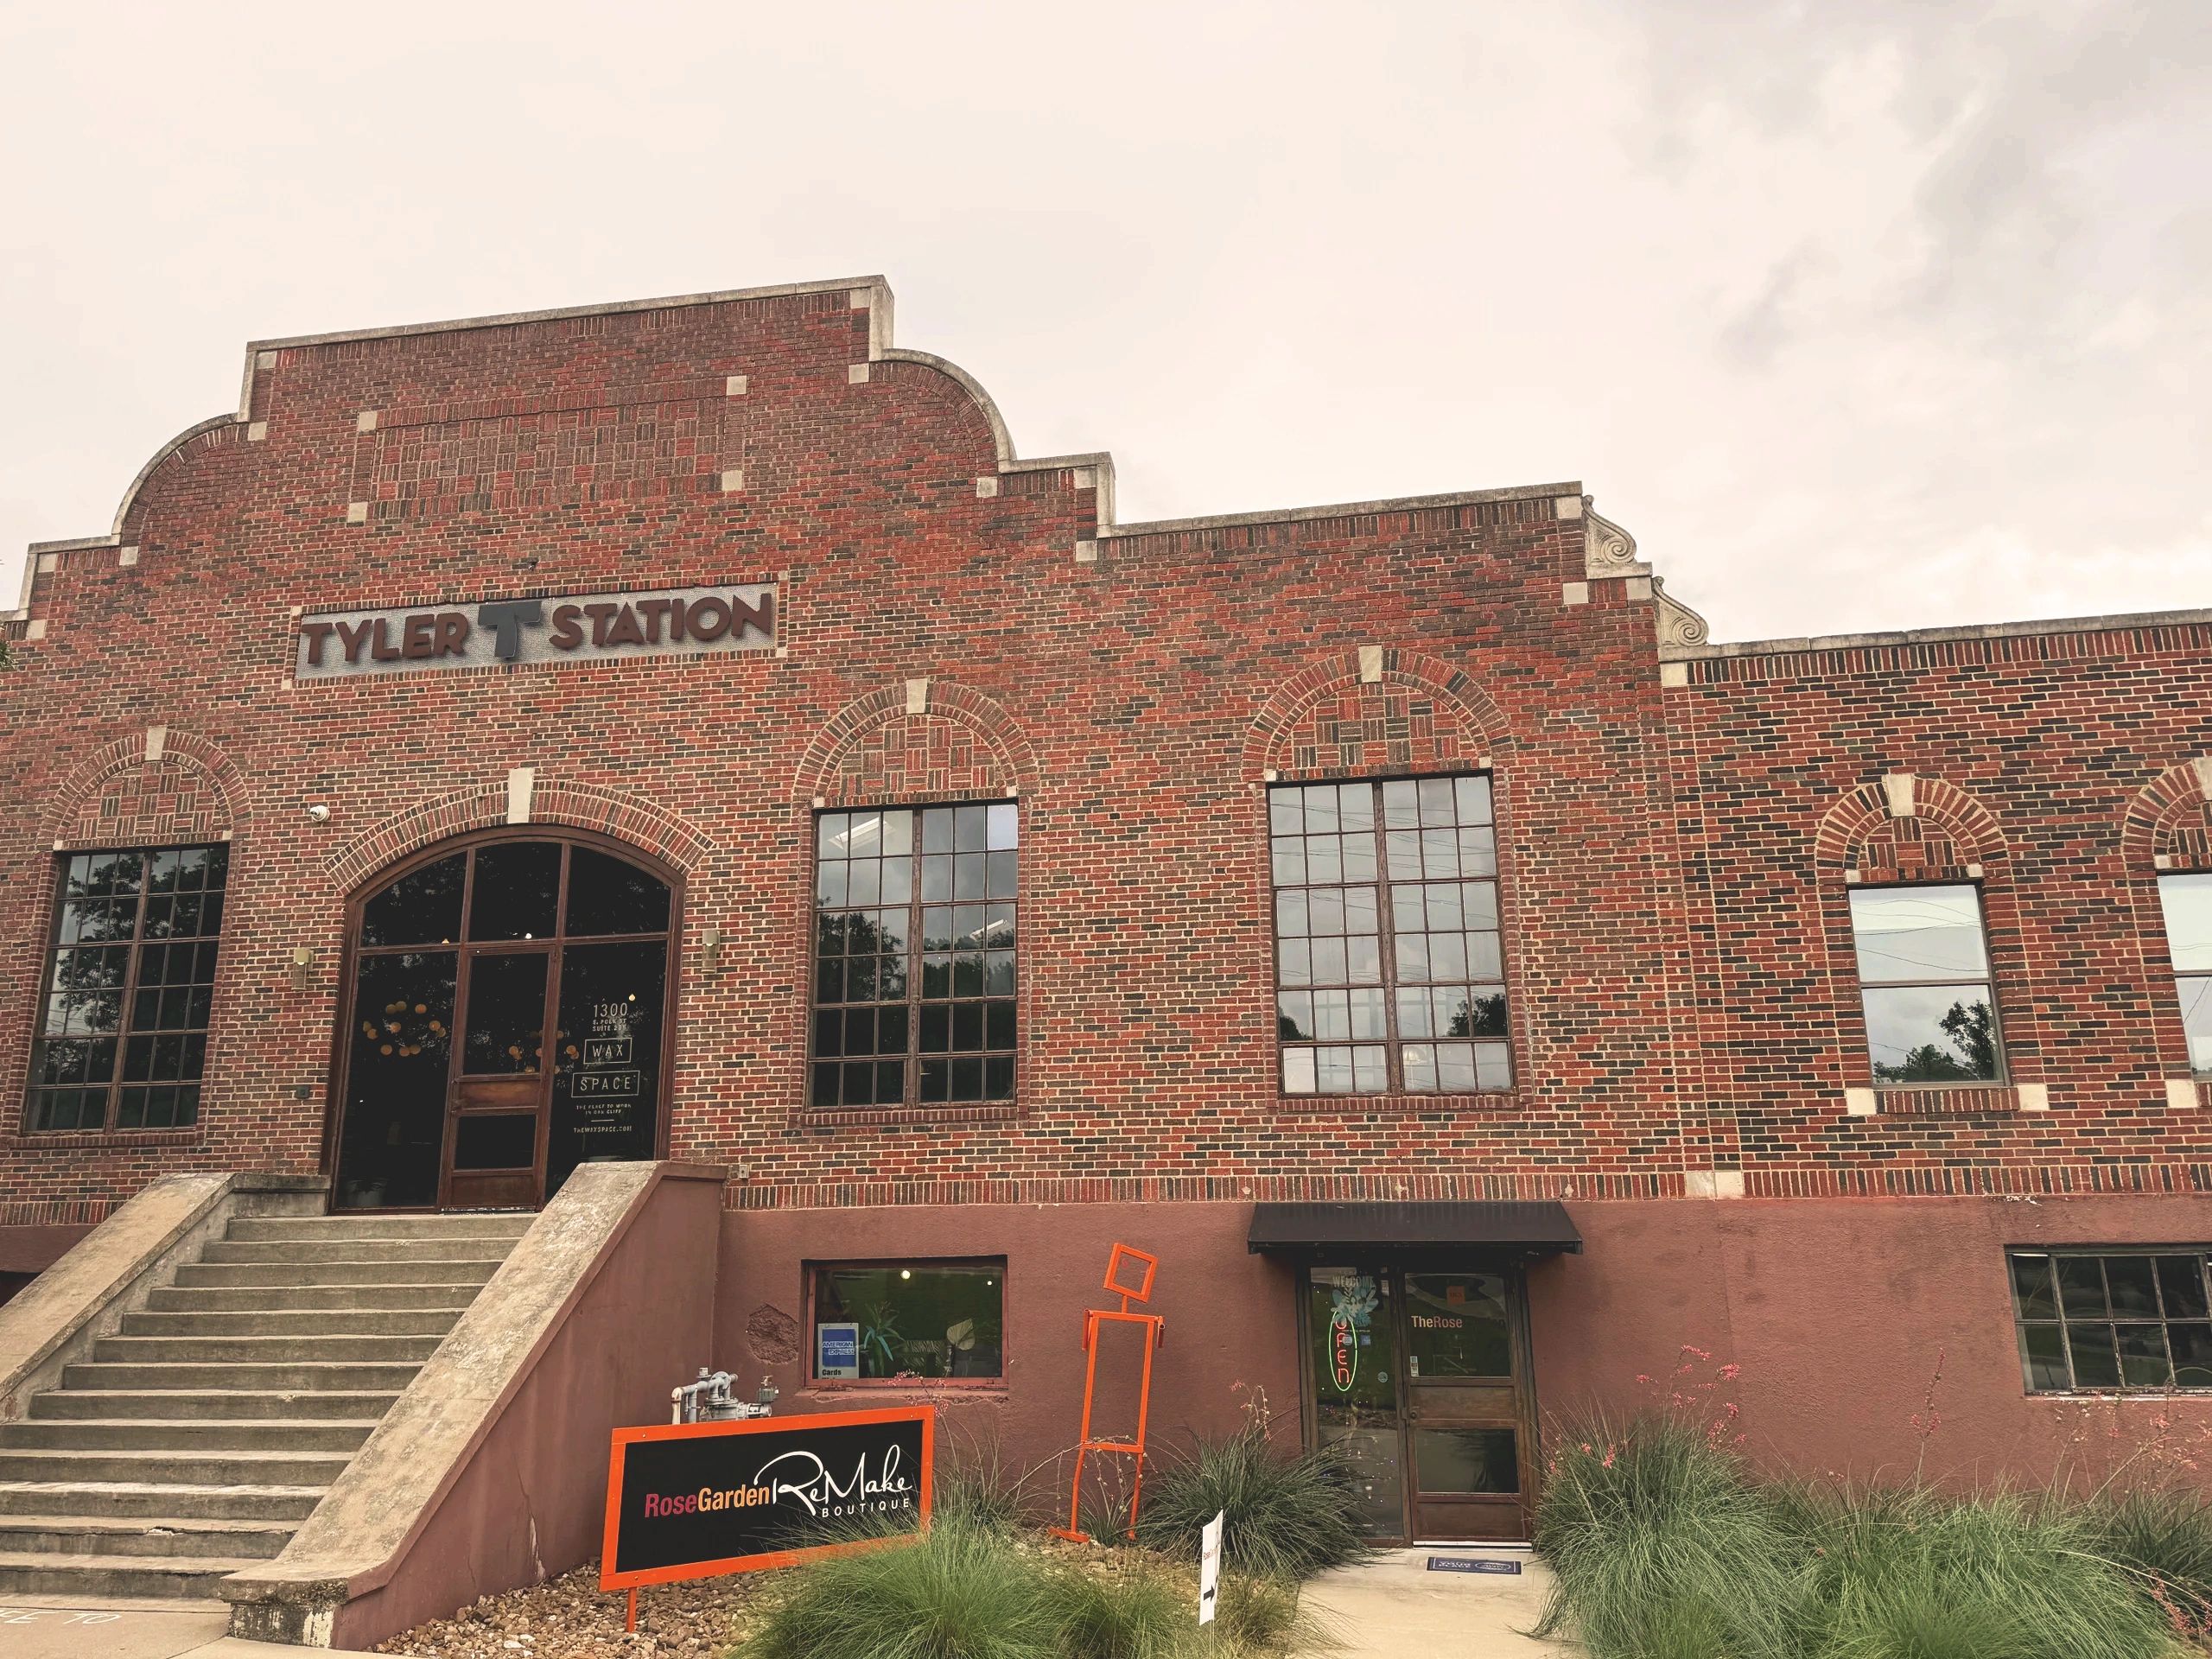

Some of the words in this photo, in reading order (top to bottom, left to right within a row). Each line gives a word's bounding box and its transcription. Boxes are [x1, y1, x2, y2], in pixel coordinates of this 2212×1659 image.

[301, 612, 469, 664] TYLER
[477, 601, 542, 659] T
[549, 592, 772, 649] STATION
[594, 1002, 628, 1018] 1300
[592, 1044, 624, 1058] WAX
[580, 1077, 631, 1091] SPACE
[573, 1125, 632, 1134] THEWAXSPACE.COM
[753, 1444, 913, 1516] ReMake
[821, 1497, 912, 1518] BOUTIQUE
